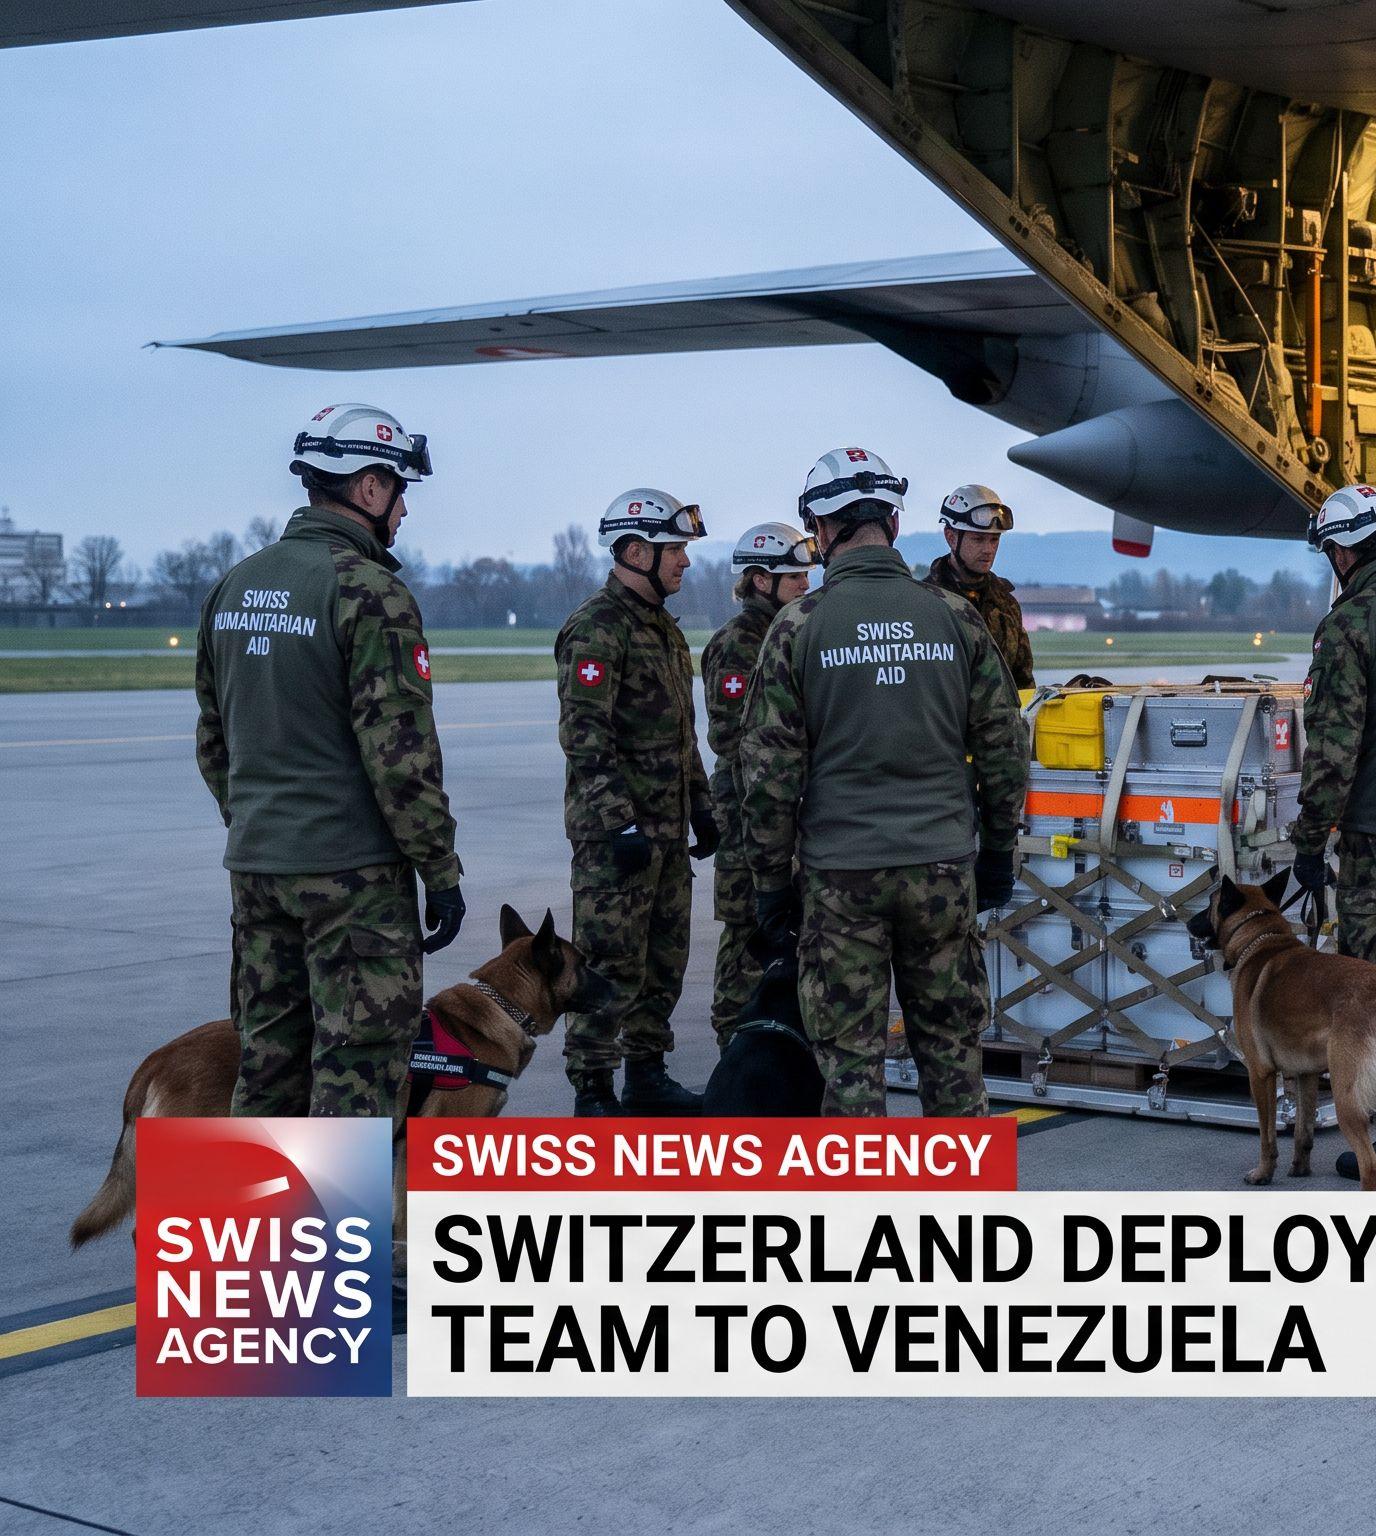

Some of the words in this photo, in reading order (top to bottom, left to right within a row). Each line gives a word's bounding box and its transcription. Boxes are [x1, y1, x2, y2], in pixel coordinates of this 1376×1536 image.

[241, 589, 290, 609] SWISS
[856, 621, 914, 641] SWISS
[245, 635, 270, 655] AID
[820, 642, 954, 668] HUMANITARIAN
[875, 666, 906, 685] AID
